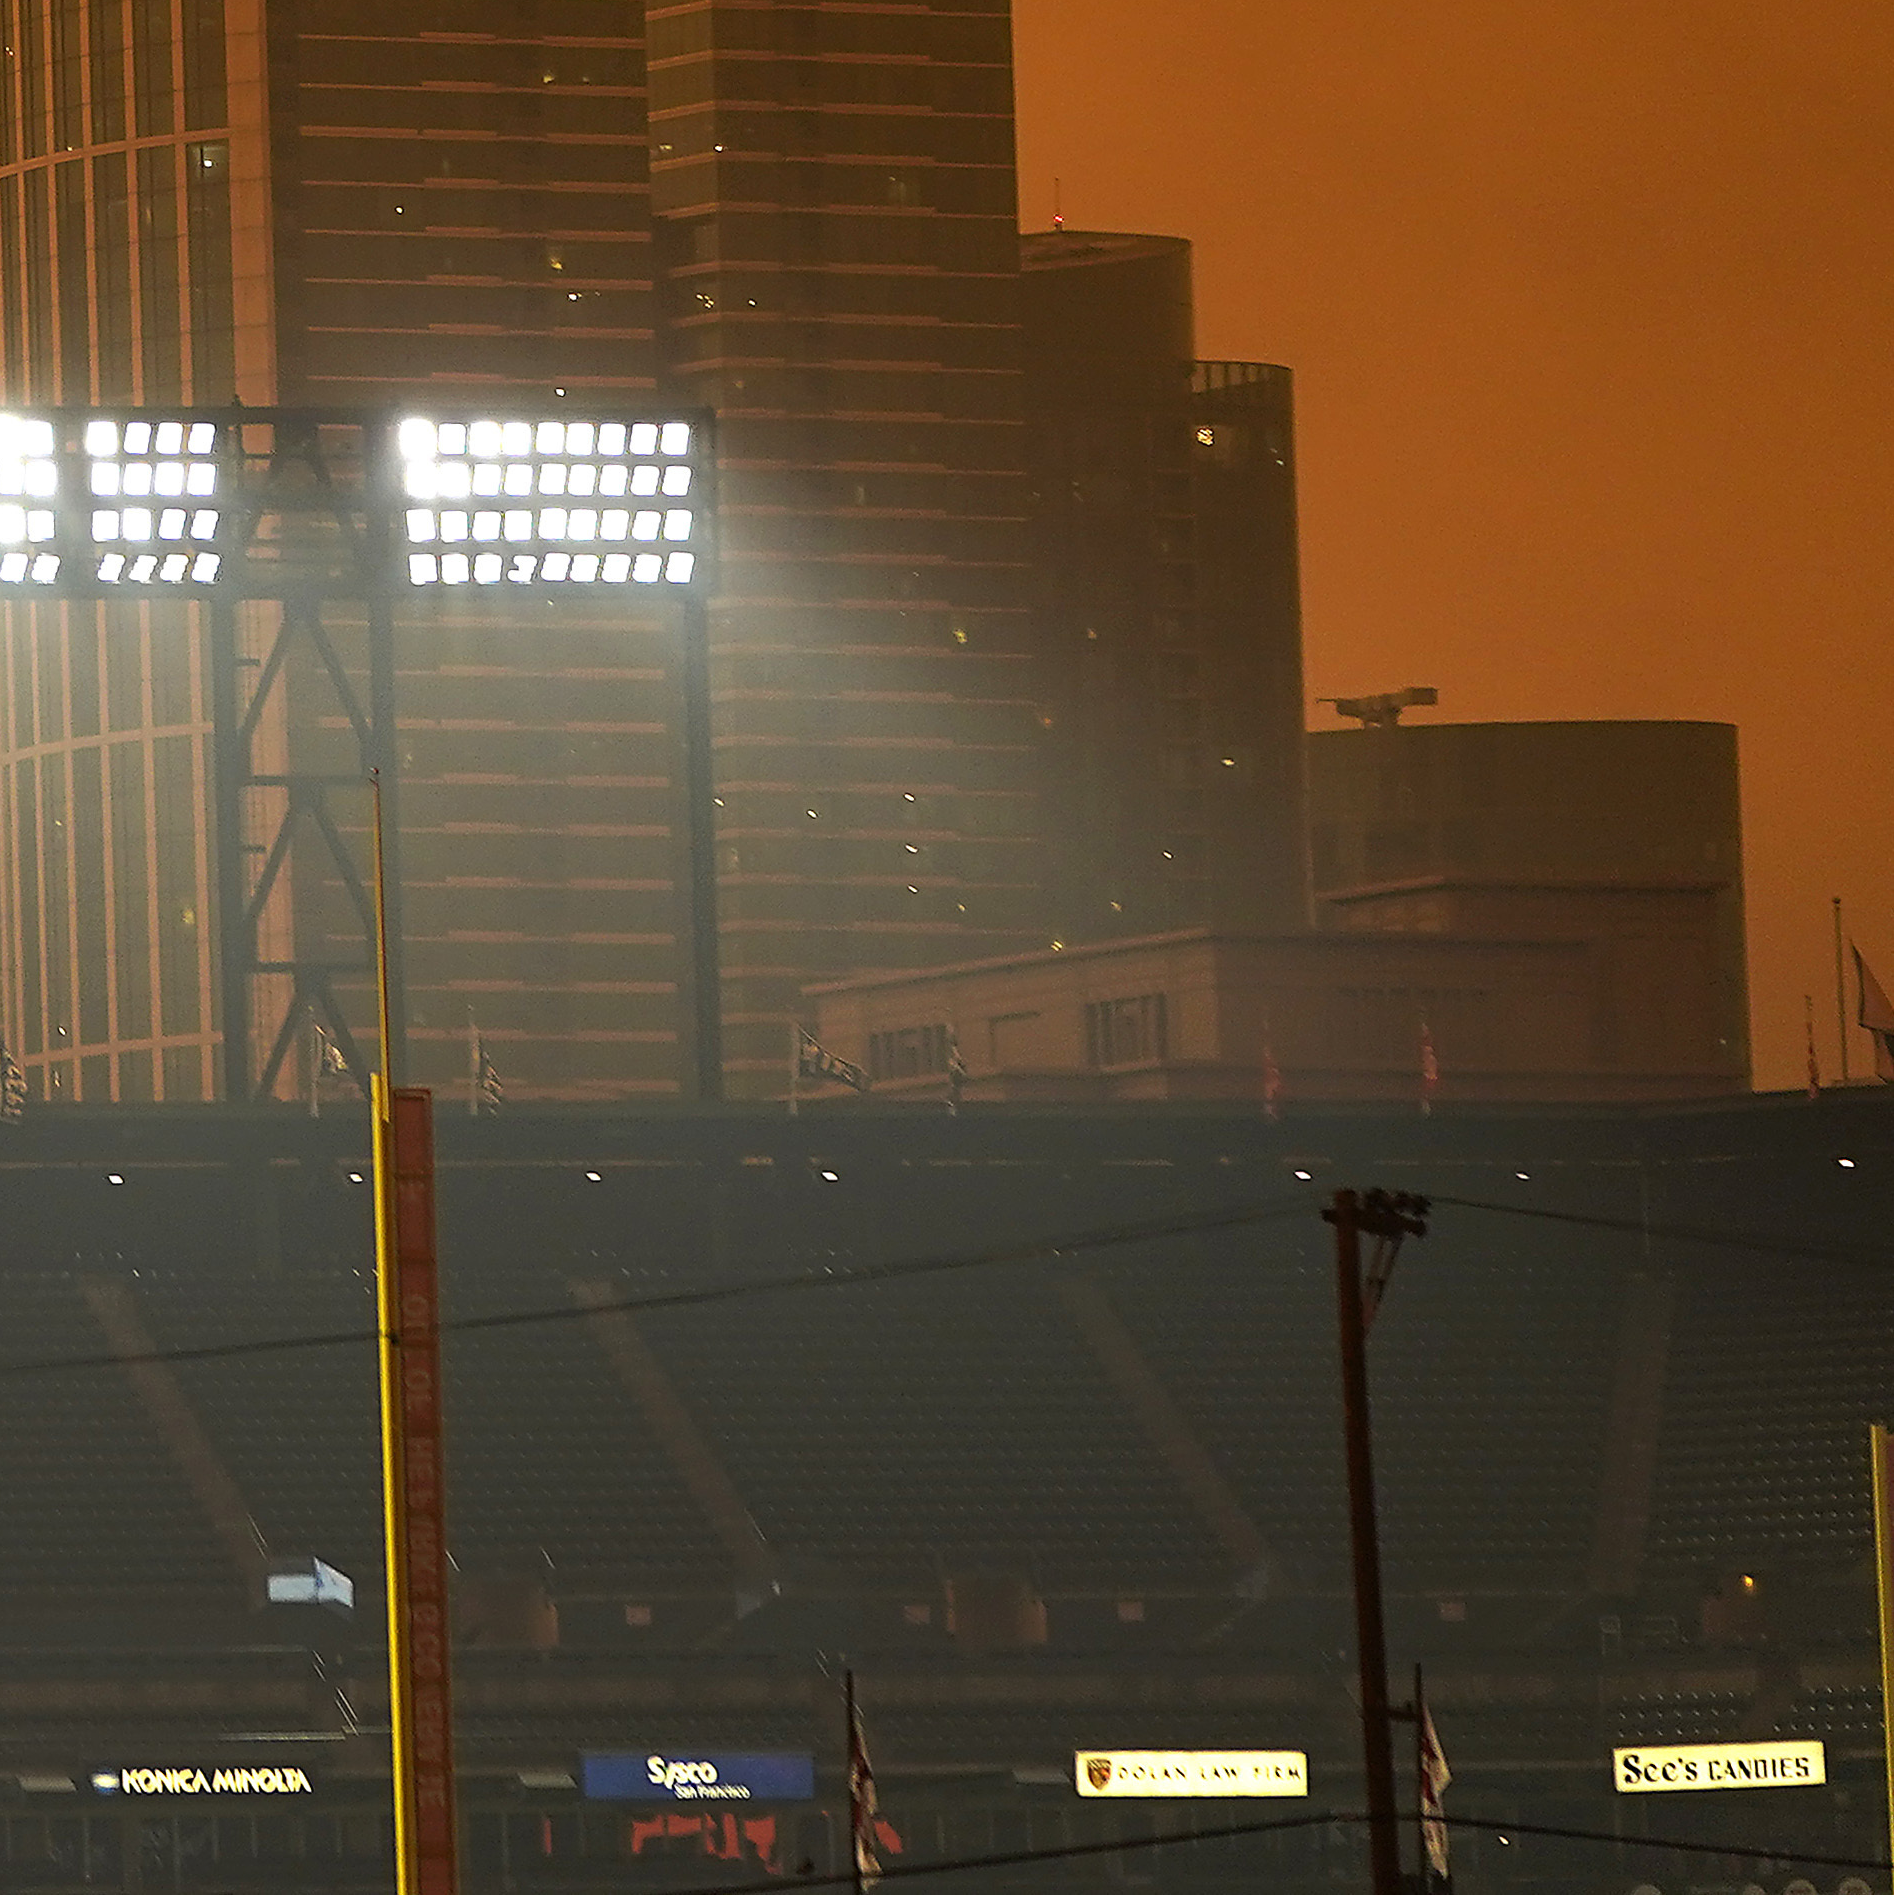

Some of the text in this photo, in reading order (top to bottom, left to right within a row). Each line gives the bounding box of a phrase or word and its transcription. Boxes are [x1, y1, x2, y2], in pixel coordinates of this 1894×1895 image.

[121, 1767, 313, 1794] KONICA MINOLTA
[647, 1755, 719, 1790] Sysco
[1622, 1754, 1810, 1785] See's CANDIES
